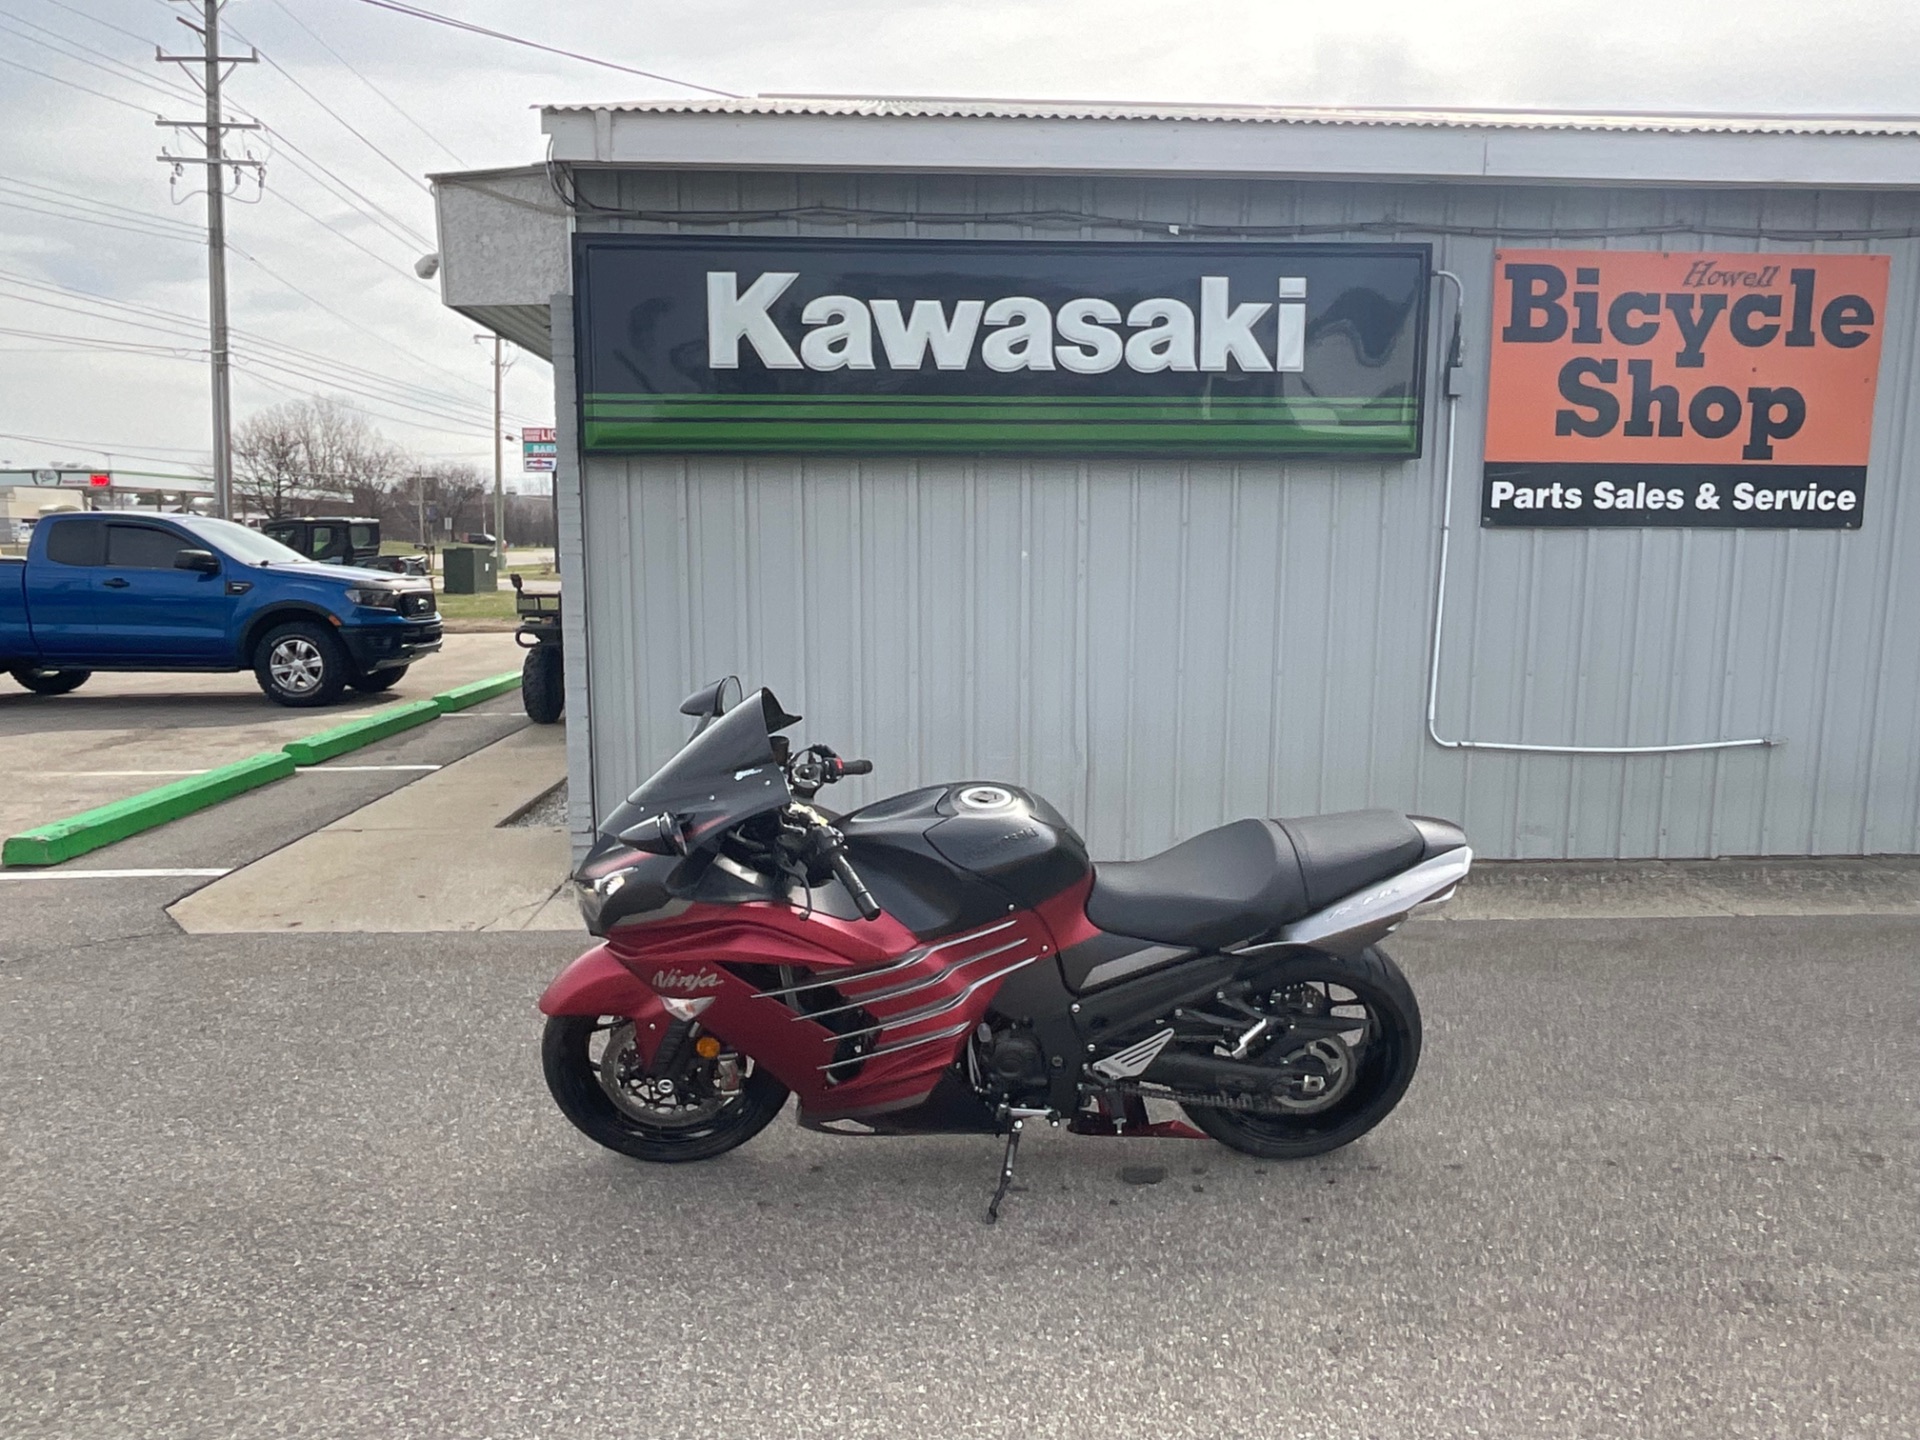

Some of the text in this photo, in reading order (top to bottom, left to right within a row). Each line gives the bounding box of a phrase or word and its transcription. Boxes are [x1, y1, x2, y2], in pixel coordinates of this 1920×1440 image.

[1682, 260, 1781, 288] Howell
[706, 271, 1307, 374] Kawasaki
[1502, 263, 1875, 368] Bicycle
[1555, 356, 1807, 460] Shop
[1490, 481, 1857, 512] Parts Sales & Service
[651, 966, 725, 993] Ninja
